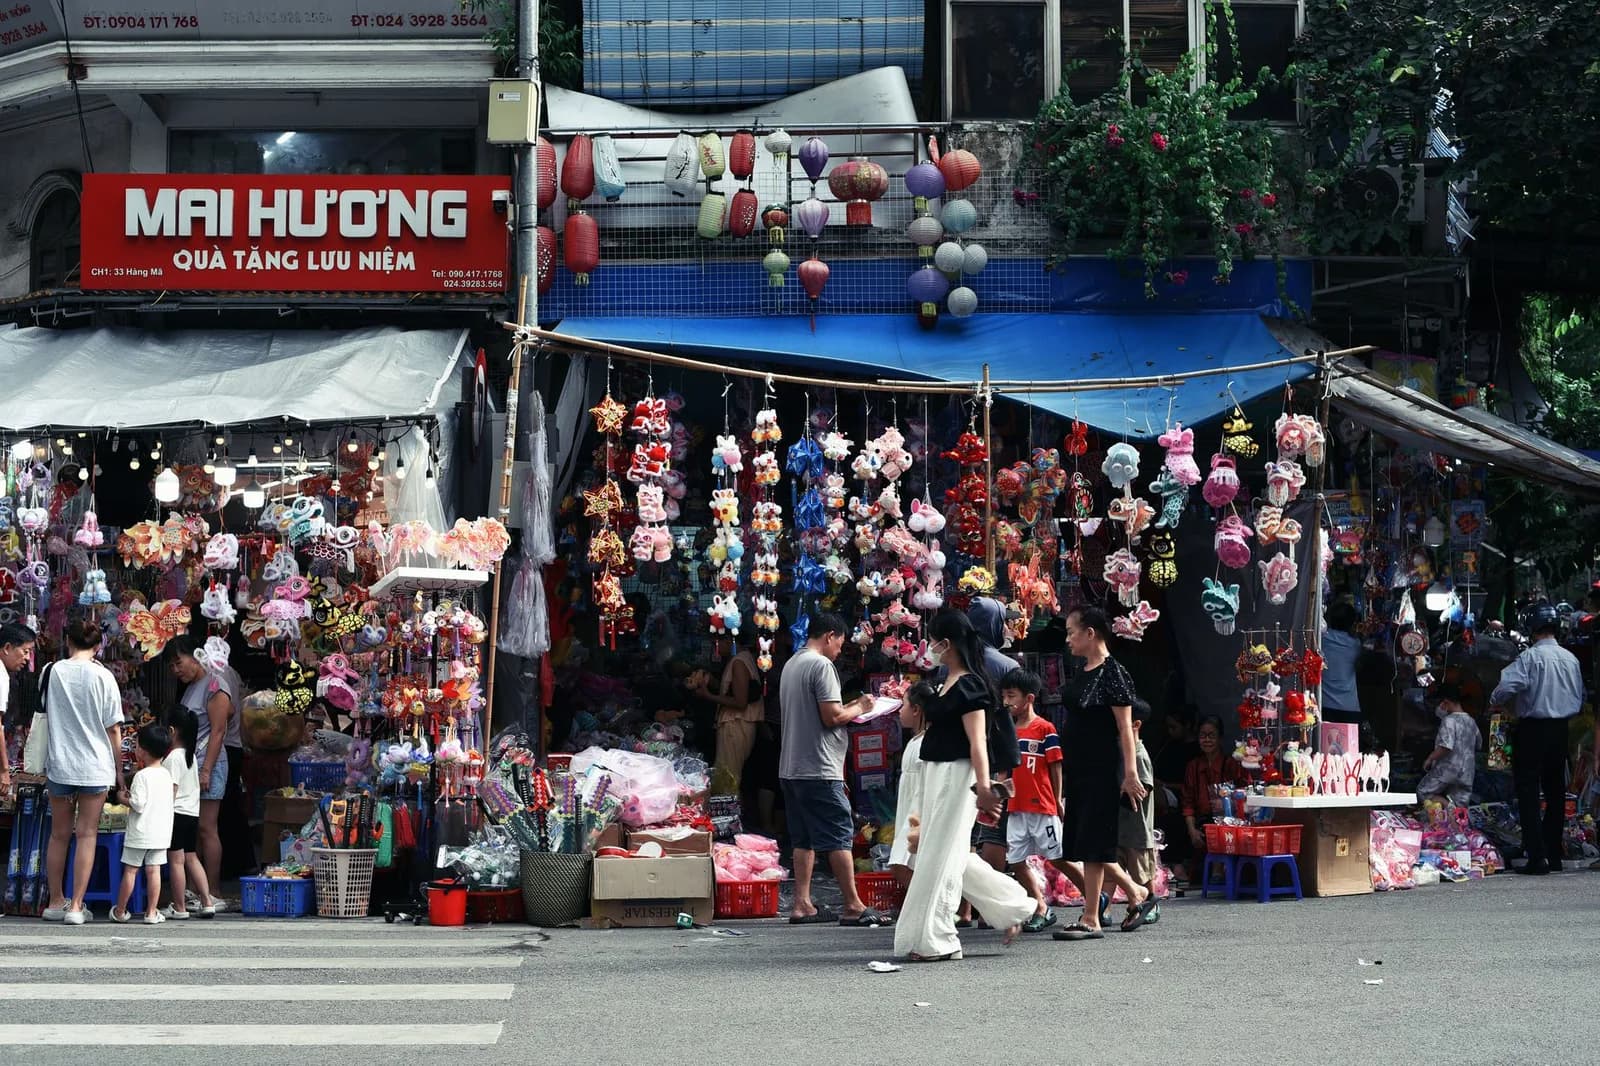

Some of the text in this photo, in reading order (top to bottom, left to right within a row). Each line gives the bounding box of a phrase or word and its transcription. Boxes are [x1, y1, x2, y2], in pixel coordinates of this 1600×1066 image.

[150, 16, 169, 28] 171
[173, 16, 198, 28] 768
[409, 15, 445, 27] 3928
[451, 15, 487, 26] 3564
[125, 188, 467, 238] MAI HƯƠNG
[173, 245, 416, 274] QUÀ TẶNG LƯU NIỆM
[91, 268, 112, 276] CH1:
[114, 268, 124, 276] 33
[126, 267, 149, 278] Hàng
[431, 270, 503, 278] Tel: 090.417.1768
[443, 280, 503, 288] 024.39283.564
[1026, 756, 1036, 774] 9
[1045, 825, 1057, 842] 9
